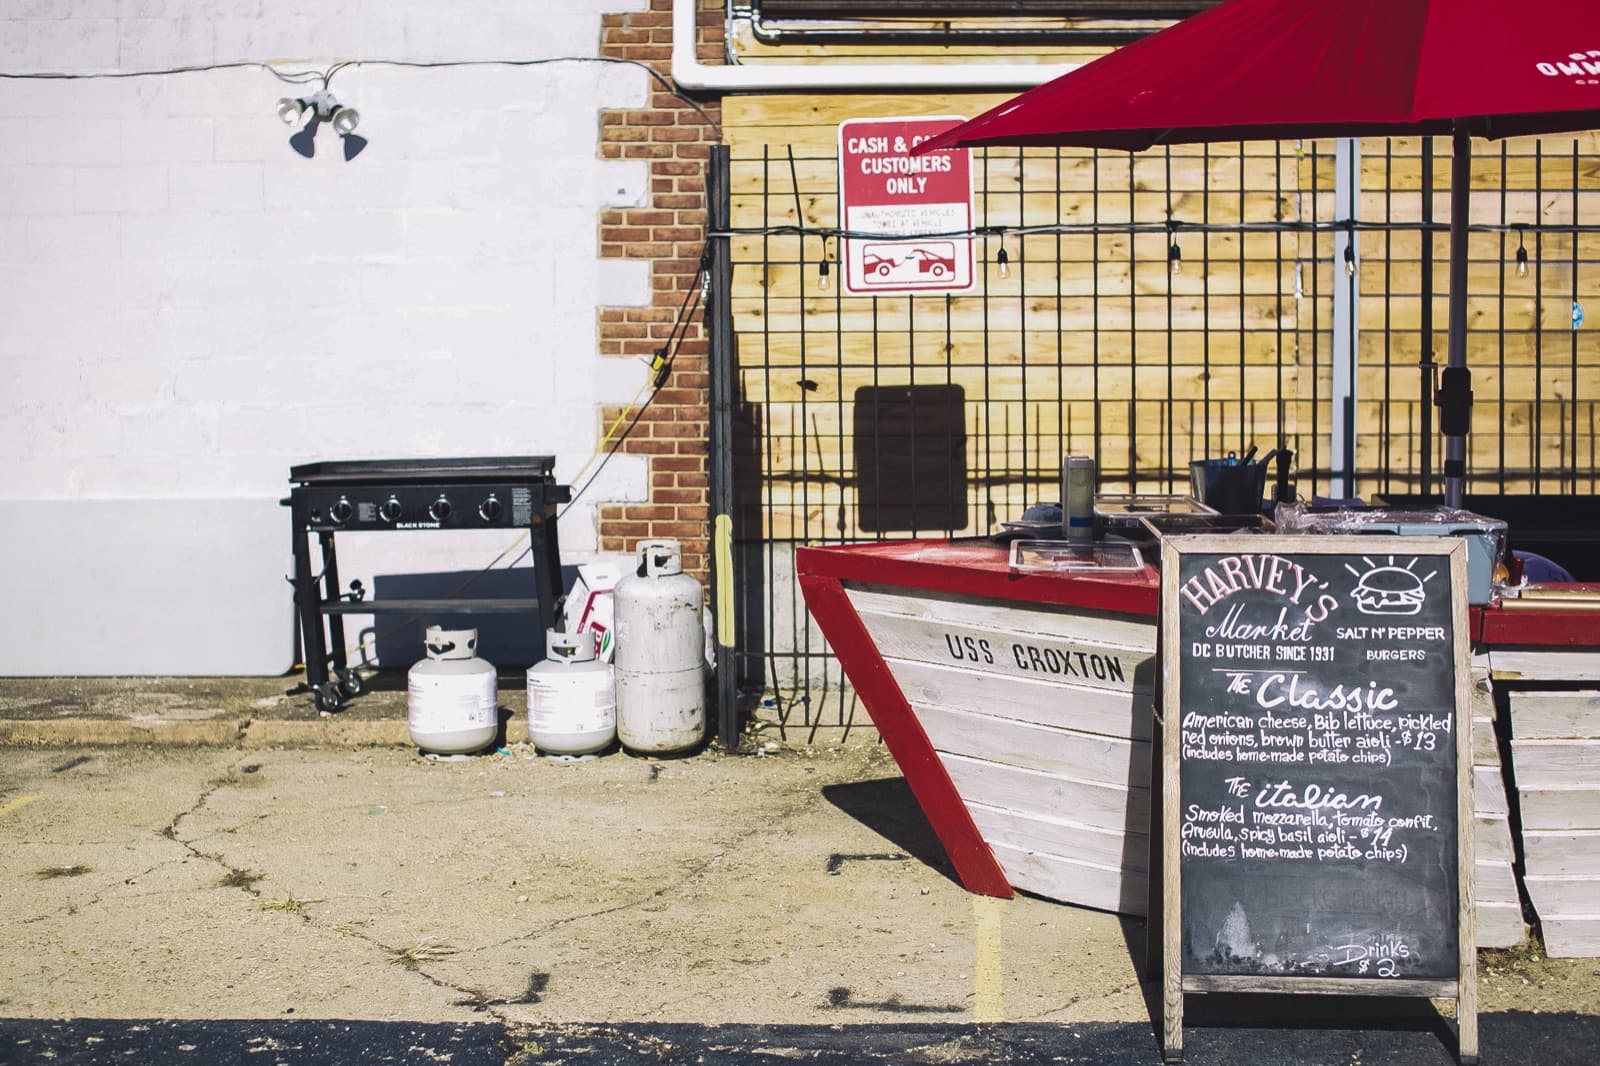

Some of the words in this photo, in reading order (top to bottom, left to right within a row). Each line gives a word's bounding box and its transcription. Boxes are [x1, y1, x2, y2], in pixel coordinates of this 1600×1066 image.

[848, 136, 888, 154] CASH
[893, 136, 908, 153] &
[861, 155, 952, 174] CUSTOMERS
[886, 176, 927, 194] ONLY
[1180, 554, 1339, 622] HARVEY'S
[1205, 602, 1314, 641] Market
[1336, 627, 1368, 640] SALT
[1388, 627, 1445, 640] PEPPER
[945, 633, 994, 665] USS
[1012, 643, 1125, 683] CROXTON
[1192, 642, 1211, 657] DC
[1216, 643, 1270, 660] BUTCHER
[1276, 645, 1307, 661] SINCE
[1309, 646, 1335, 661] 1931
[1366, 649, 1426, 661] BURGERS
[1257, 674, 1398, 713] Classic
[1182, 711, 1254, 729] American
[1258, 710, 1312, 730] cheese,
[1314, 711, 1340, 730] Bib
[1343, 711, 1397, 733] lettuce,
[1398, 712, 1452, 734] pickled
[1182, 728, 1206, 746] red
[1209, 730, 1259, 748] onions,
[1260, 729, 1304, 748] brown
[1308, 730, 1351, 748] butter
[1356, 731, 1391, 749] aioli
[1182, 744, 1233, 760] (includes
[1236, 746, 1305, 762] home-made
[1308, 749, 1349, 764] potato
[1352, 748, 1391, 767] chips)
[1253, 808, 1333, 829] mozzarella,
[1332, 810, 1386, 827] tomato
[1239, 825, 1275, 844] spicy
[1278, 826, 1314, 844] basil
[1317, 826, 1345, 844] aioli
[1182, 839, 1236, 857] (includes
[1241, 842, 1314, 859] home-made
[1317, 841, 1362, 861] potato
[1365, 843, 1408, 863] chips)
[1333, 941, 1410, 966] Drinks
